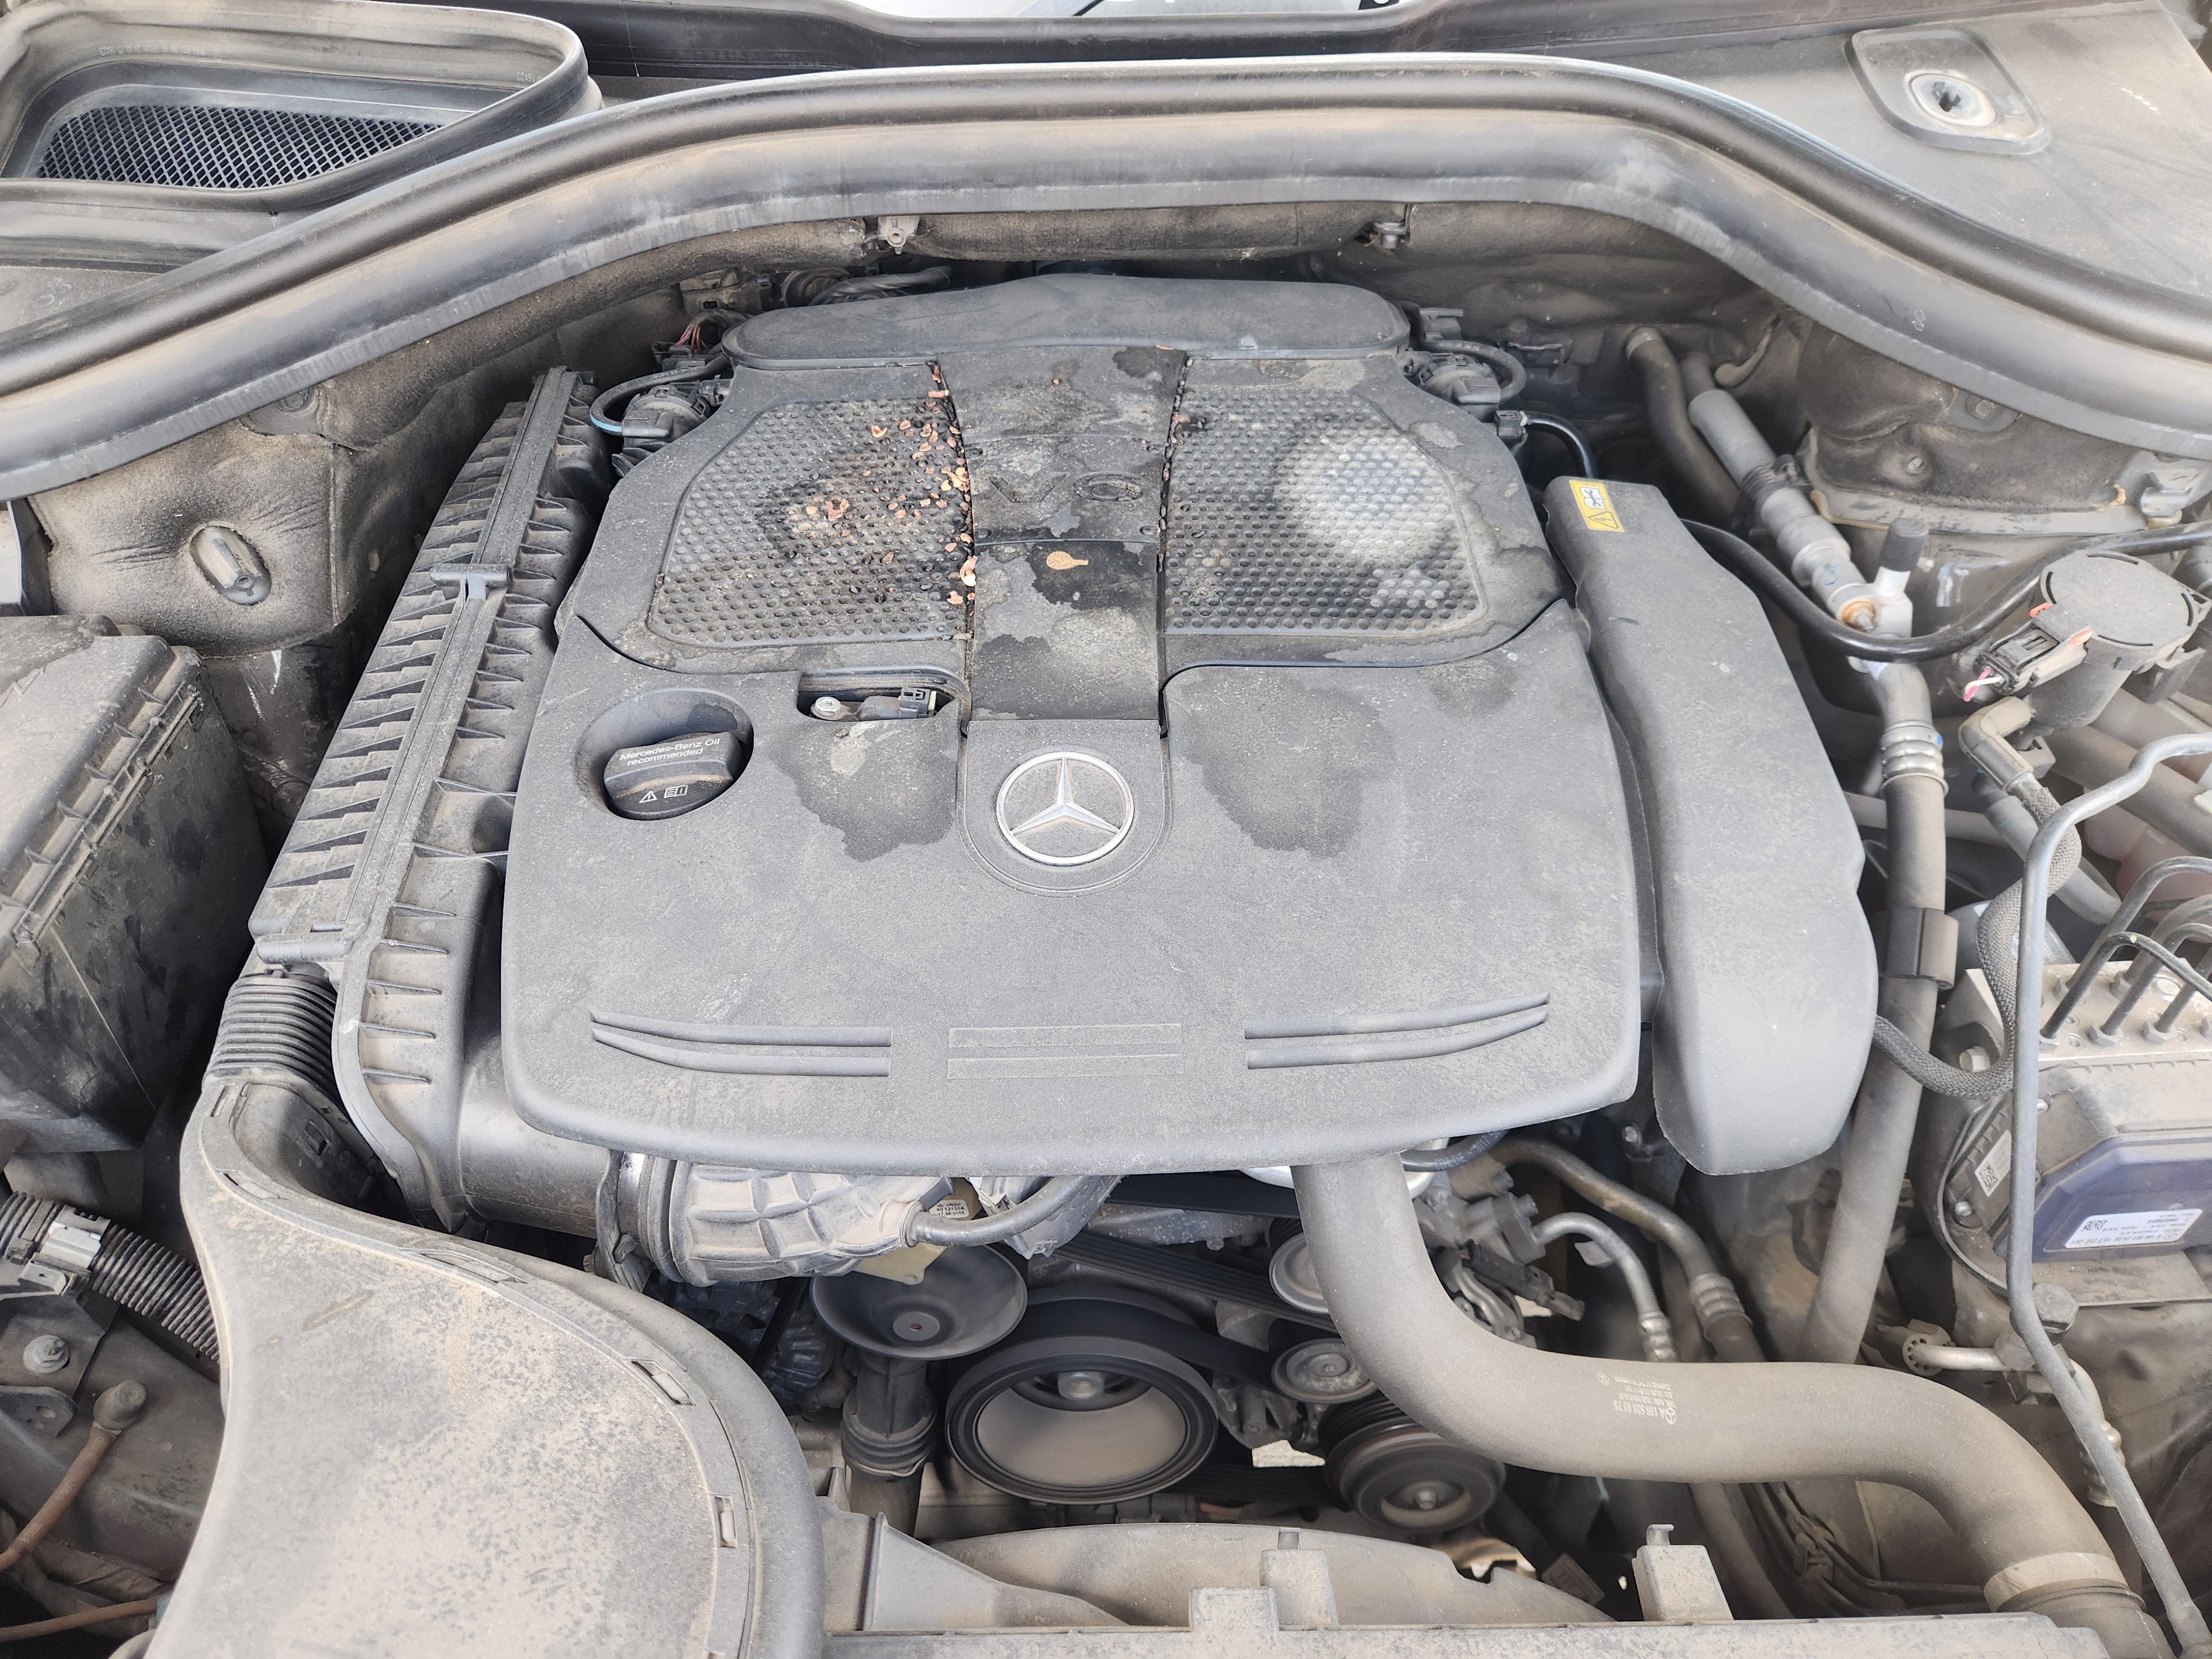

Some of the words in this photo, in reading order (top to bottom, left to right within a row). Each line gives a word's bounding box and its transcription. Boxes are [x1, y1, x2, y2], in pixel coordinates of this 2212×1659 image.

[988, 471, 1144, 503] V6
[619, 742, 702, 760] Mercedes-Benz
[627, 748, 703, 766] recommended
